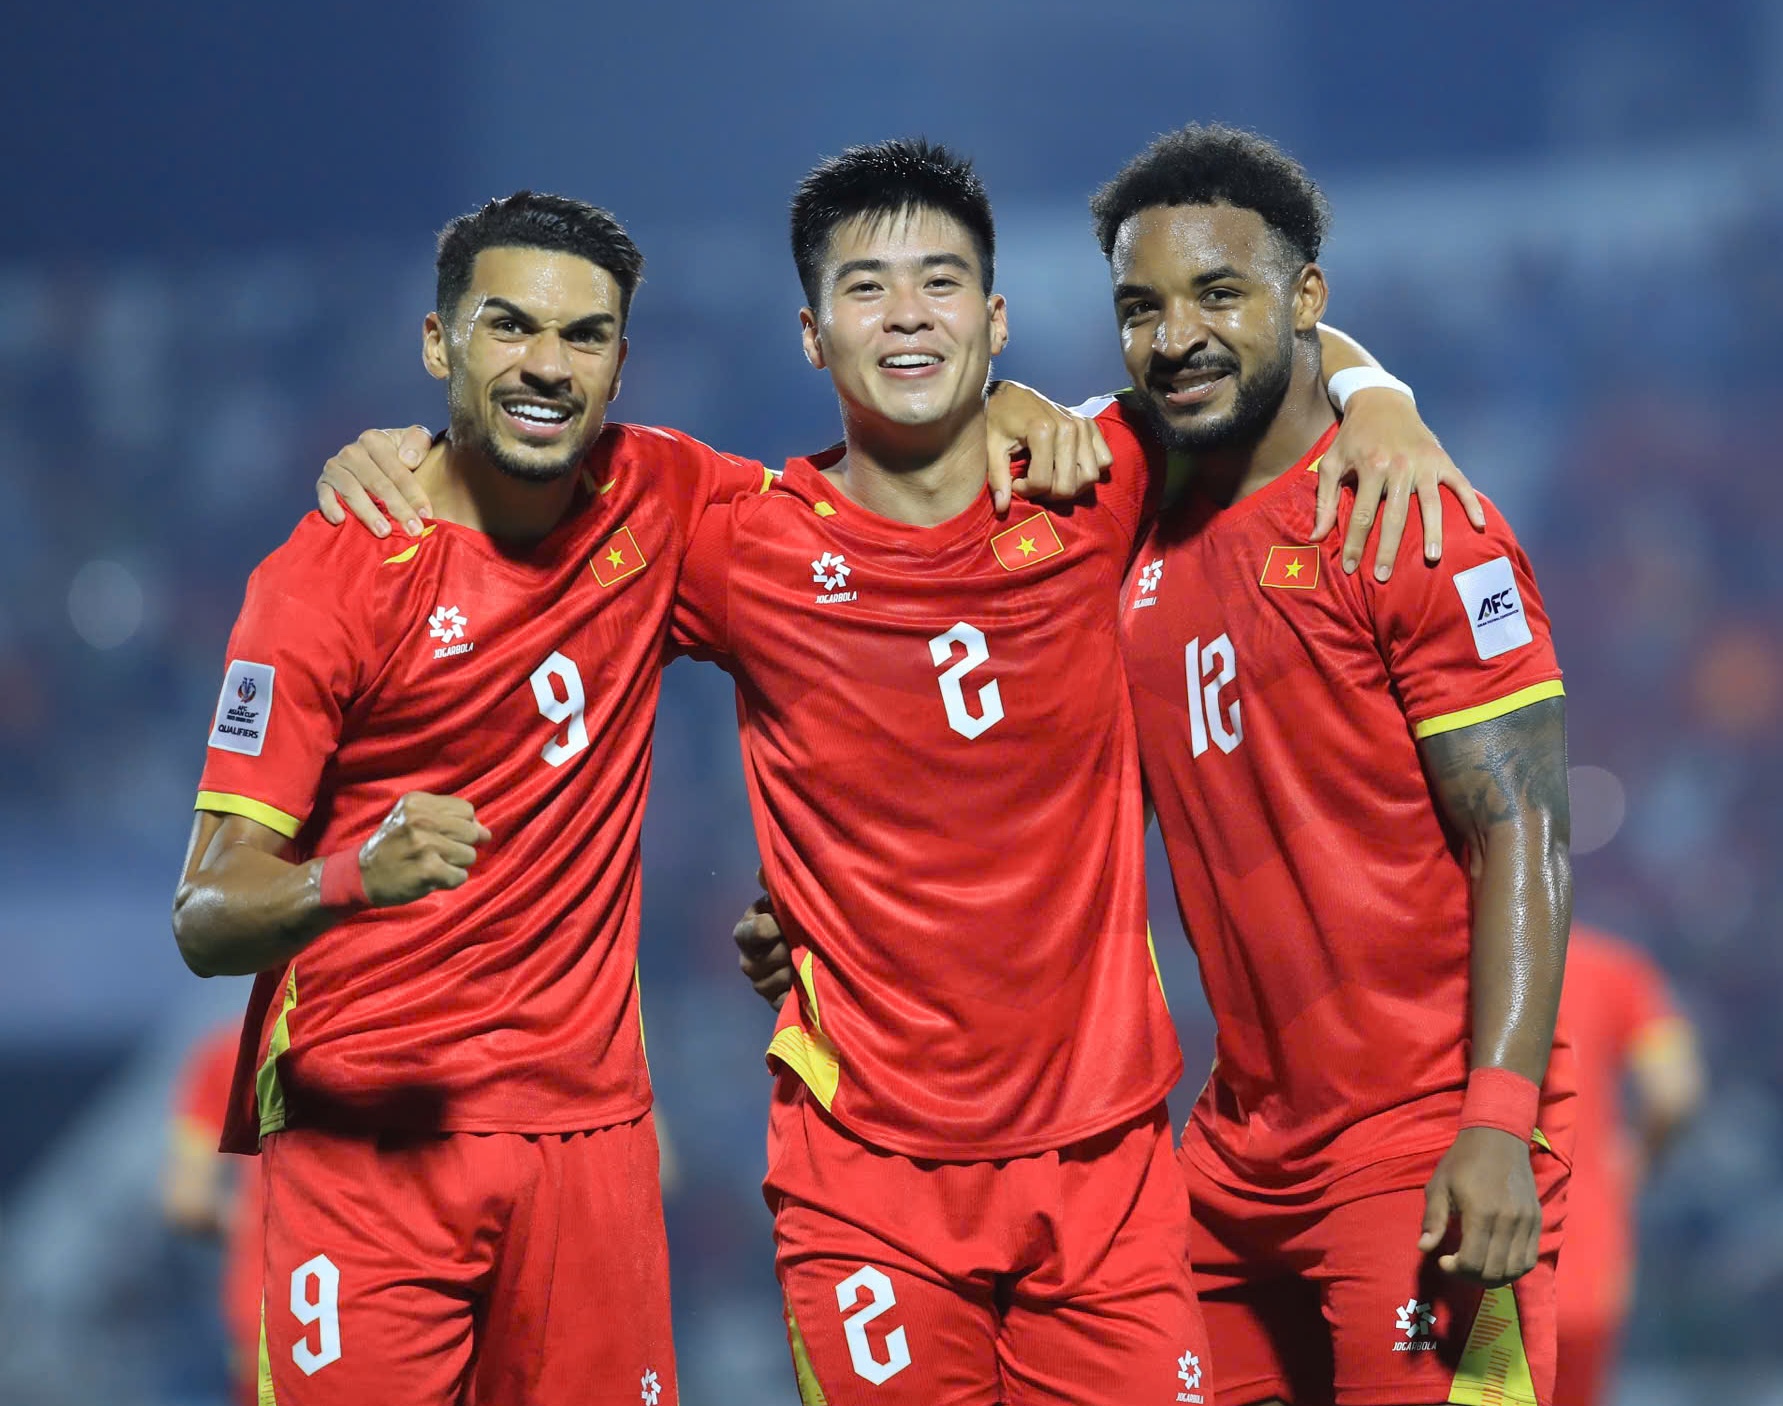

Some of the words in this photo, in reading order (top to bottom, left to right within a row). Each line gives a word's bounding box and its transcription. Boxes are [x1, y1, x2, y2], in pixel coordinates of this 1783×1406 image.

[1478, 590, 1513, 620] AFC
[218, 724, 260, 739] QUALIFIERS
[529, 650, 590, 768] 9
[928, 620, 1005, 740] 2
[1185, 632, 1244, 759] 12
[290, 1253, 342, 1377] 9
[835, 1264, 912, 1386] 2
